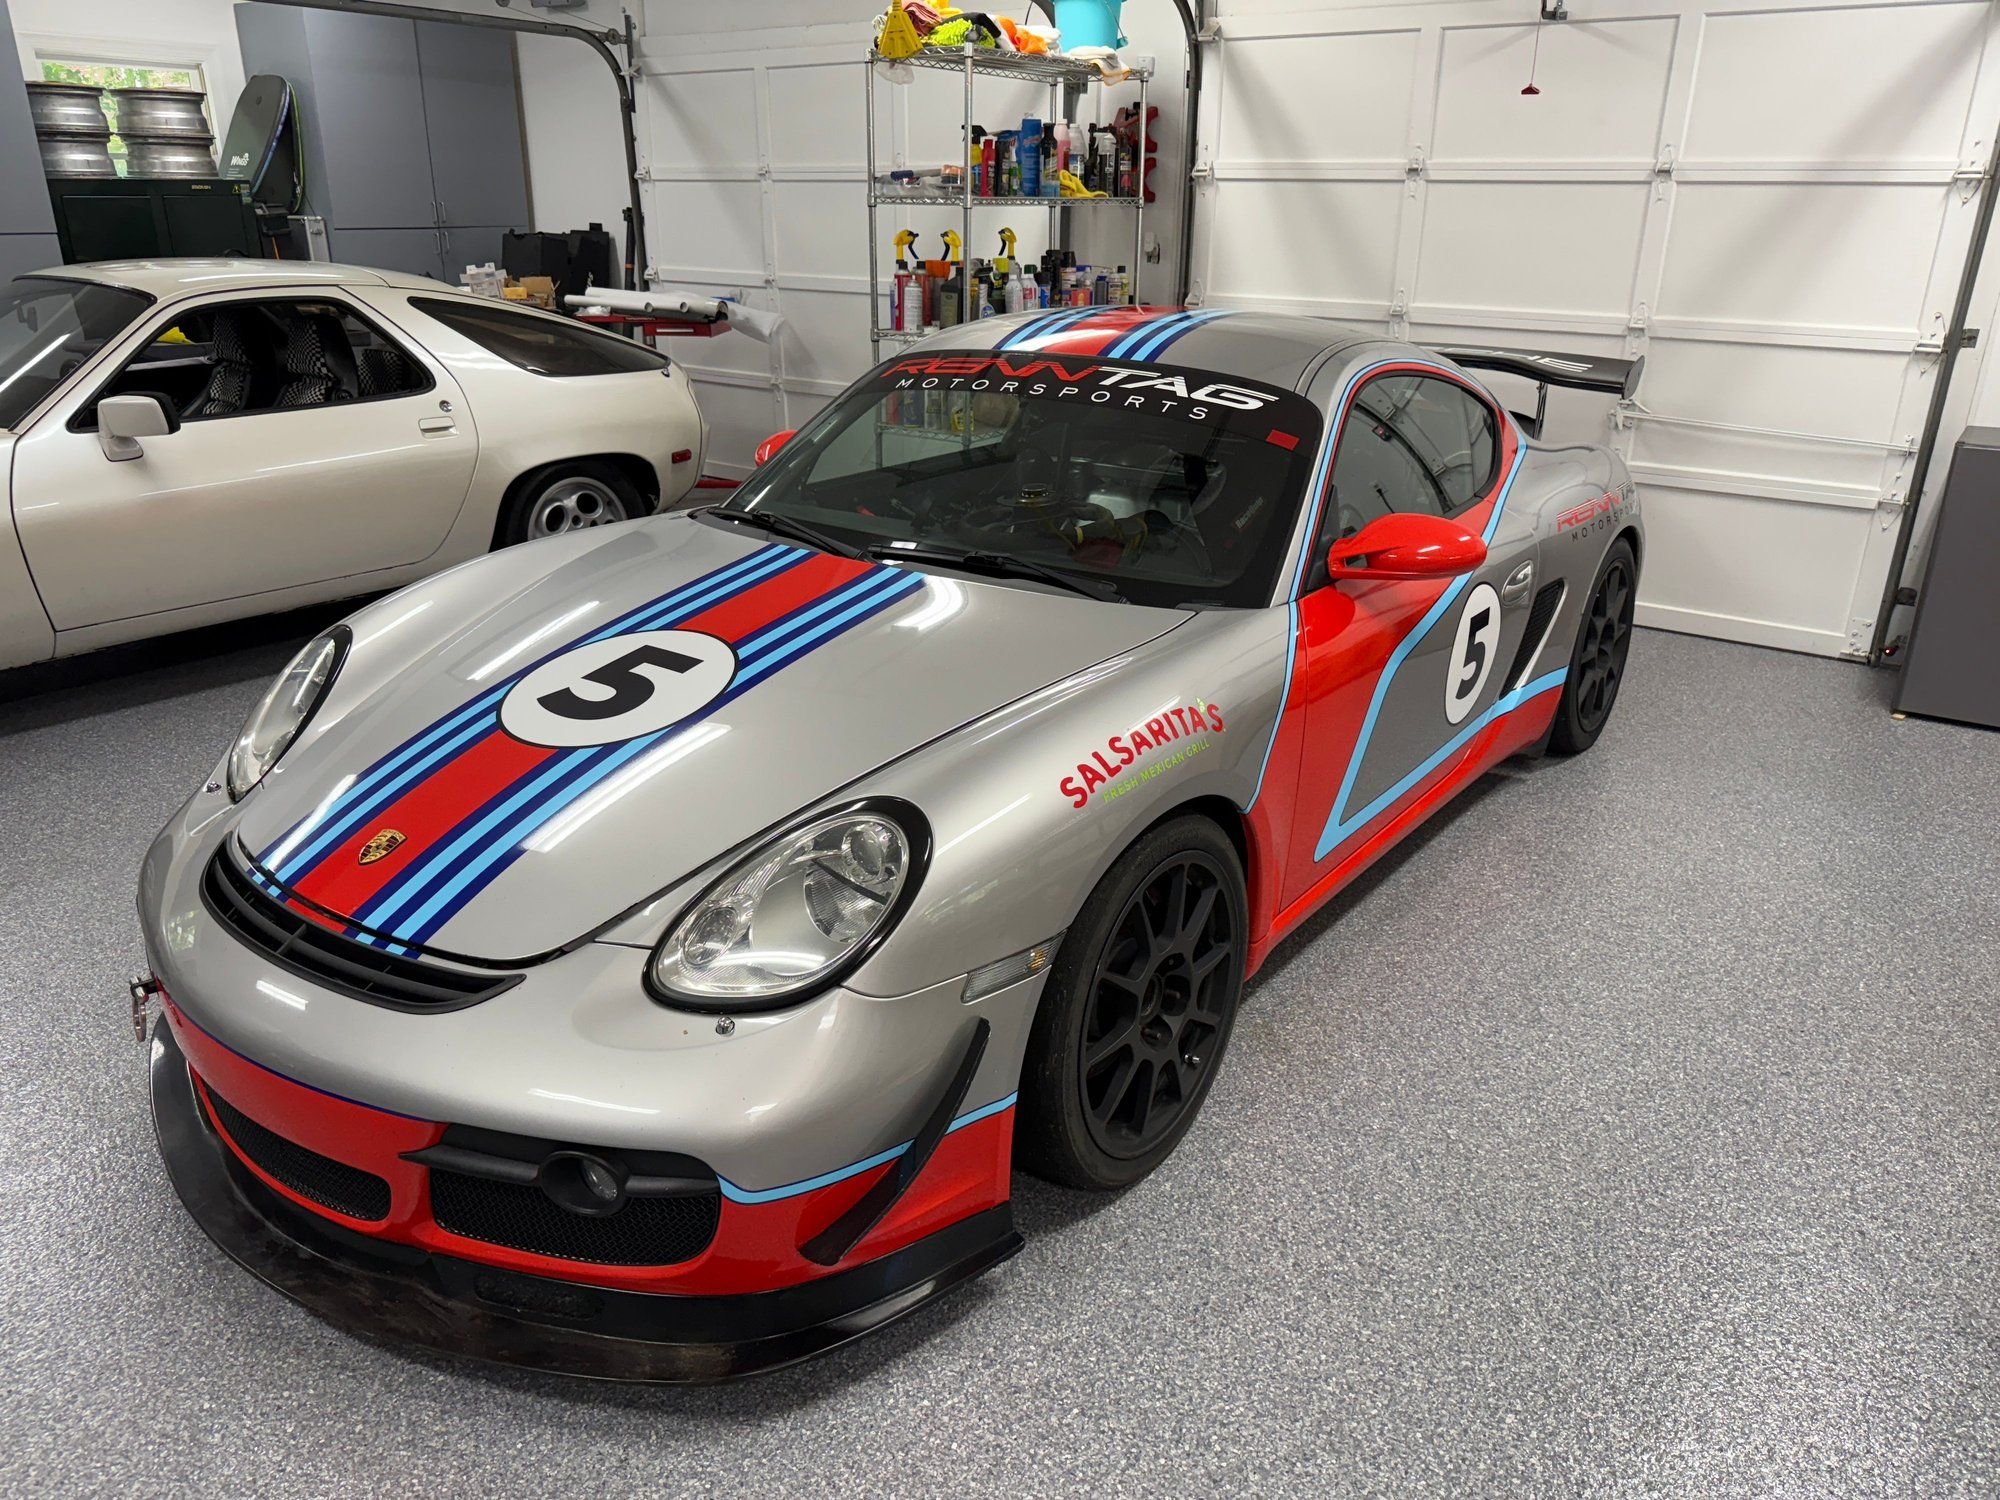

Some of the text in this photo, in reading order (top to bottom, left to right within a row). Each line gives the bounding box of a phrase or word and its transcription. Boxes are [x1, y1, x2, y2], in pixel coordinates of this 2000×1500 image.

[895, 378, 1208, 420] MOTORSPORTS
[537, 644, 704, 720] 5
[1455, 606, 1491, 700] 5
[1103, 739, 1210, 804] FRESH MEXICAN GRILL
